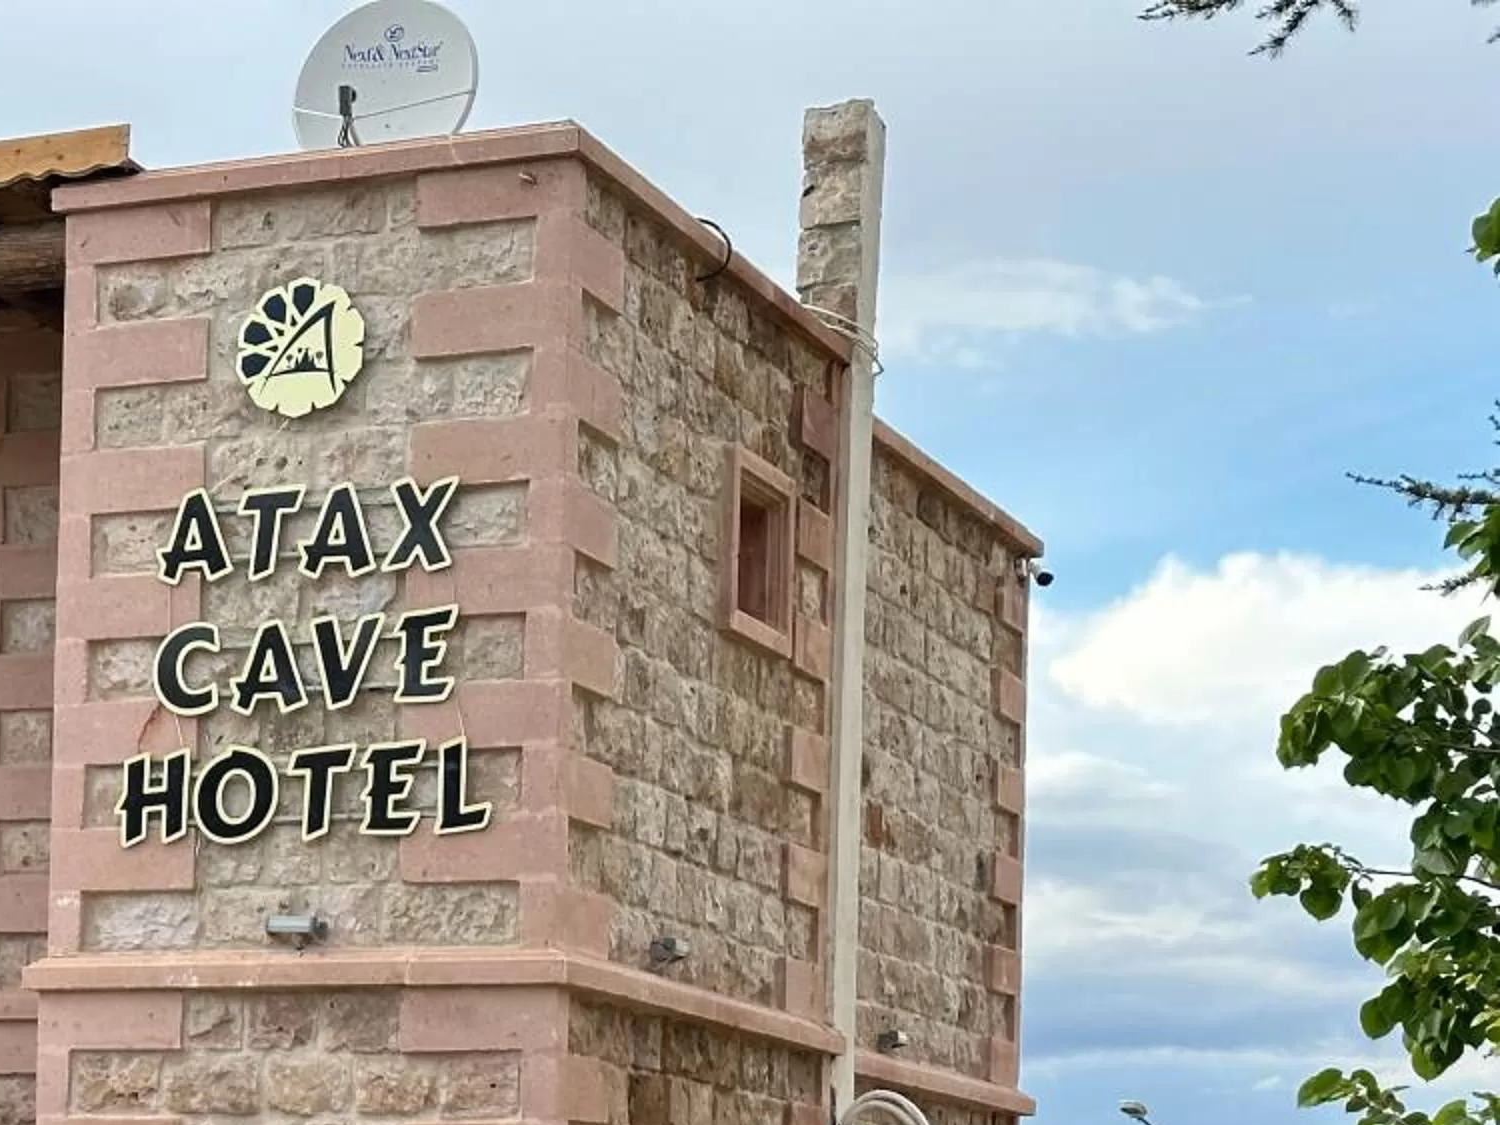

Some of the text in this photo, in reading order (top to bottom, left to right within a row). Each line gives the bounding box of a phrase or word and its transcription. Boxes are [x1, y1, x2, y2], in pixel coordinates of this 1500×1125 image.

[157, 475, 460, 586] ATAX
[153, 604, 459, 717] CAVE
[115, 735, 492, 849] HOTEL
